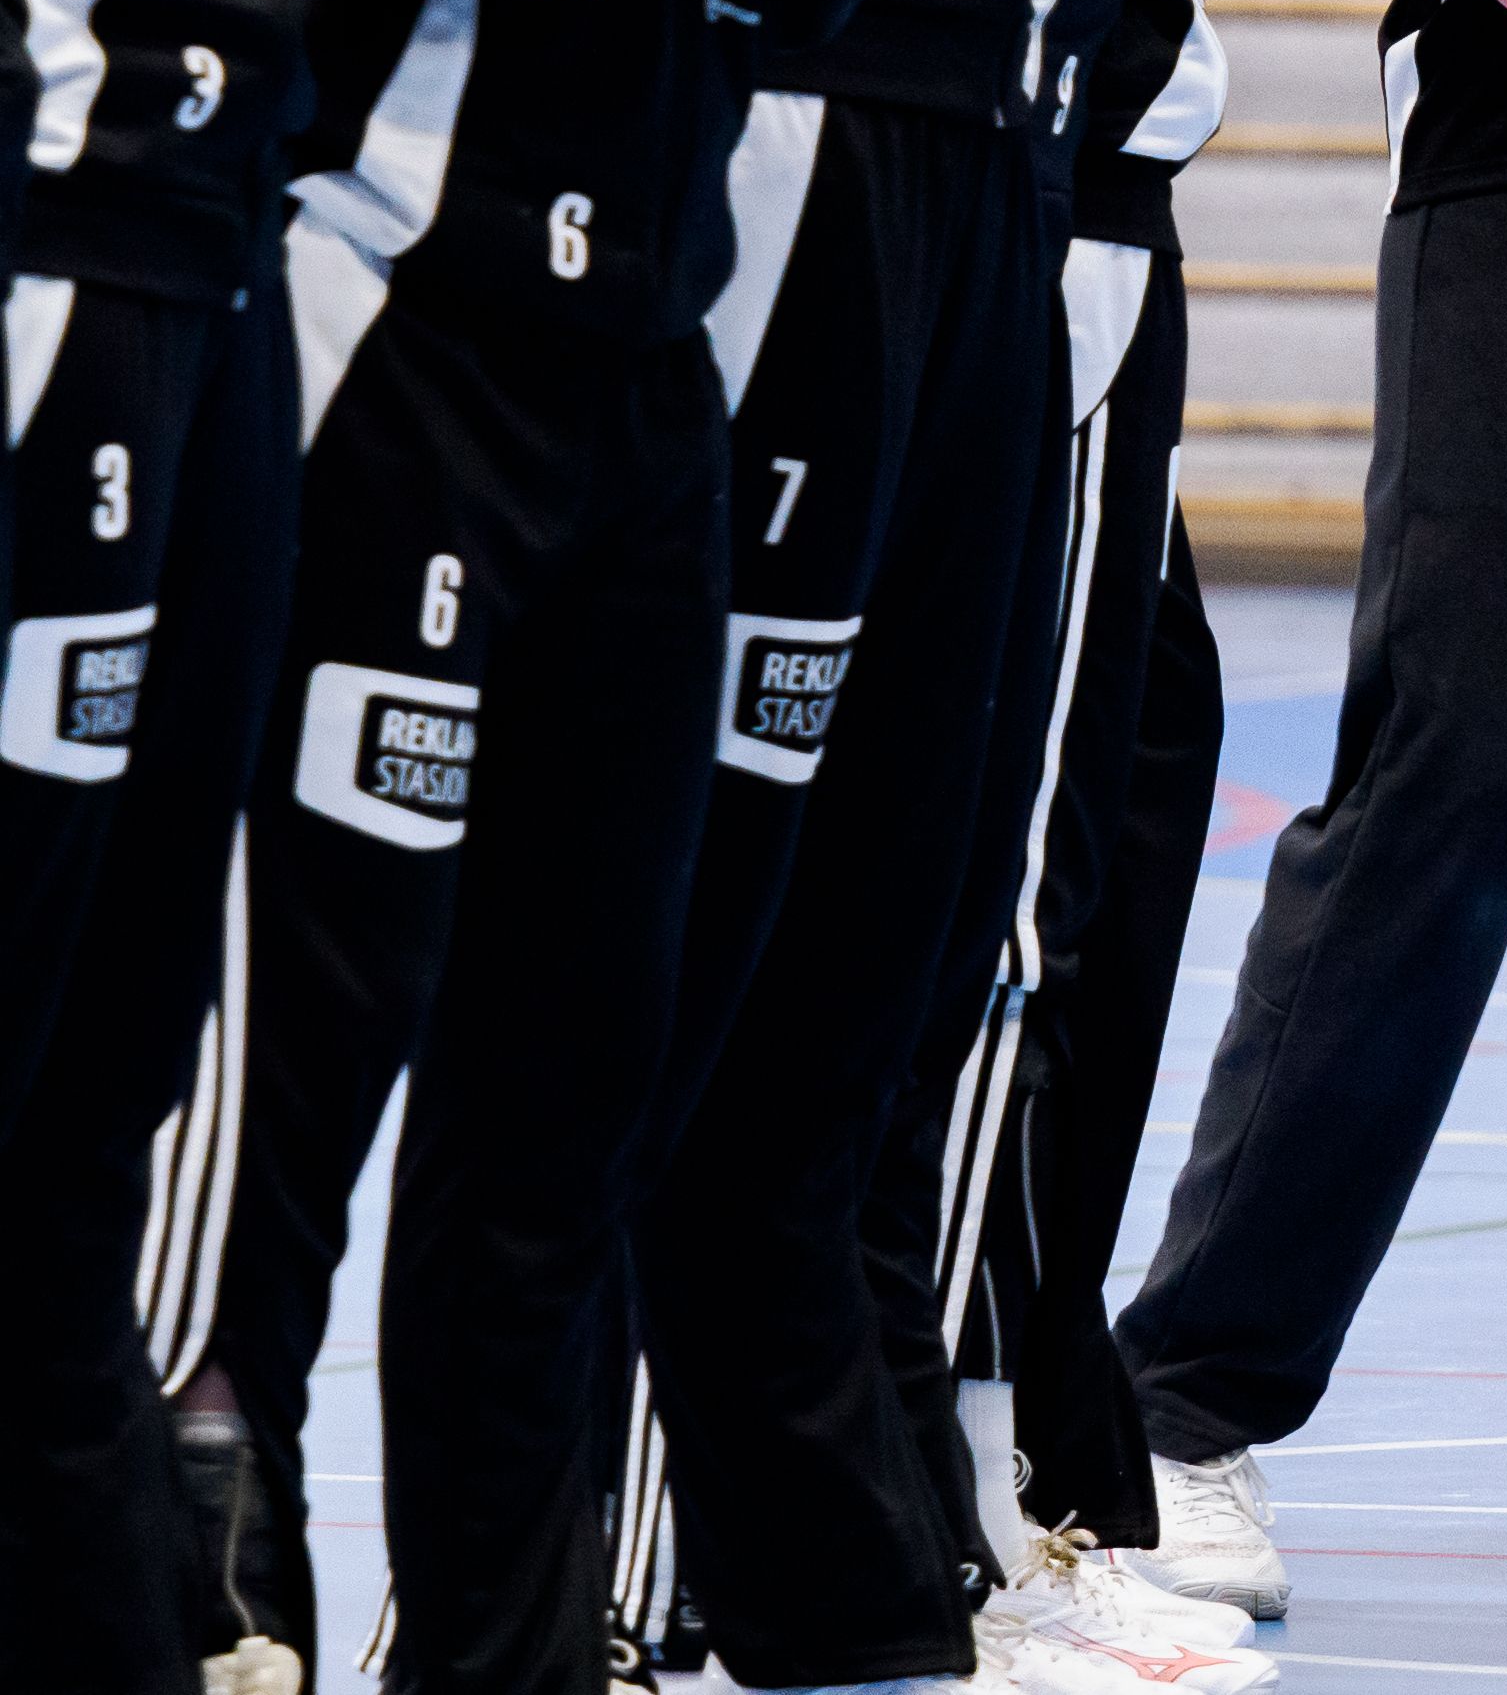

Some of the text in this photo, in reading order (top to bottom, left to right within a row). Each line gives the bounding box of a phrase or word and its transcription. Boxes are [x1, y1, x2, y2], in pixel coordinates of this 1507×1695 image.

[173, 45, 226, 130] 3
[548, 191, 594, 280] 6
[91, 442, 132, 541] 3
[764, 456, 808, 545] 7
[419, 553, 464, 648] 6
